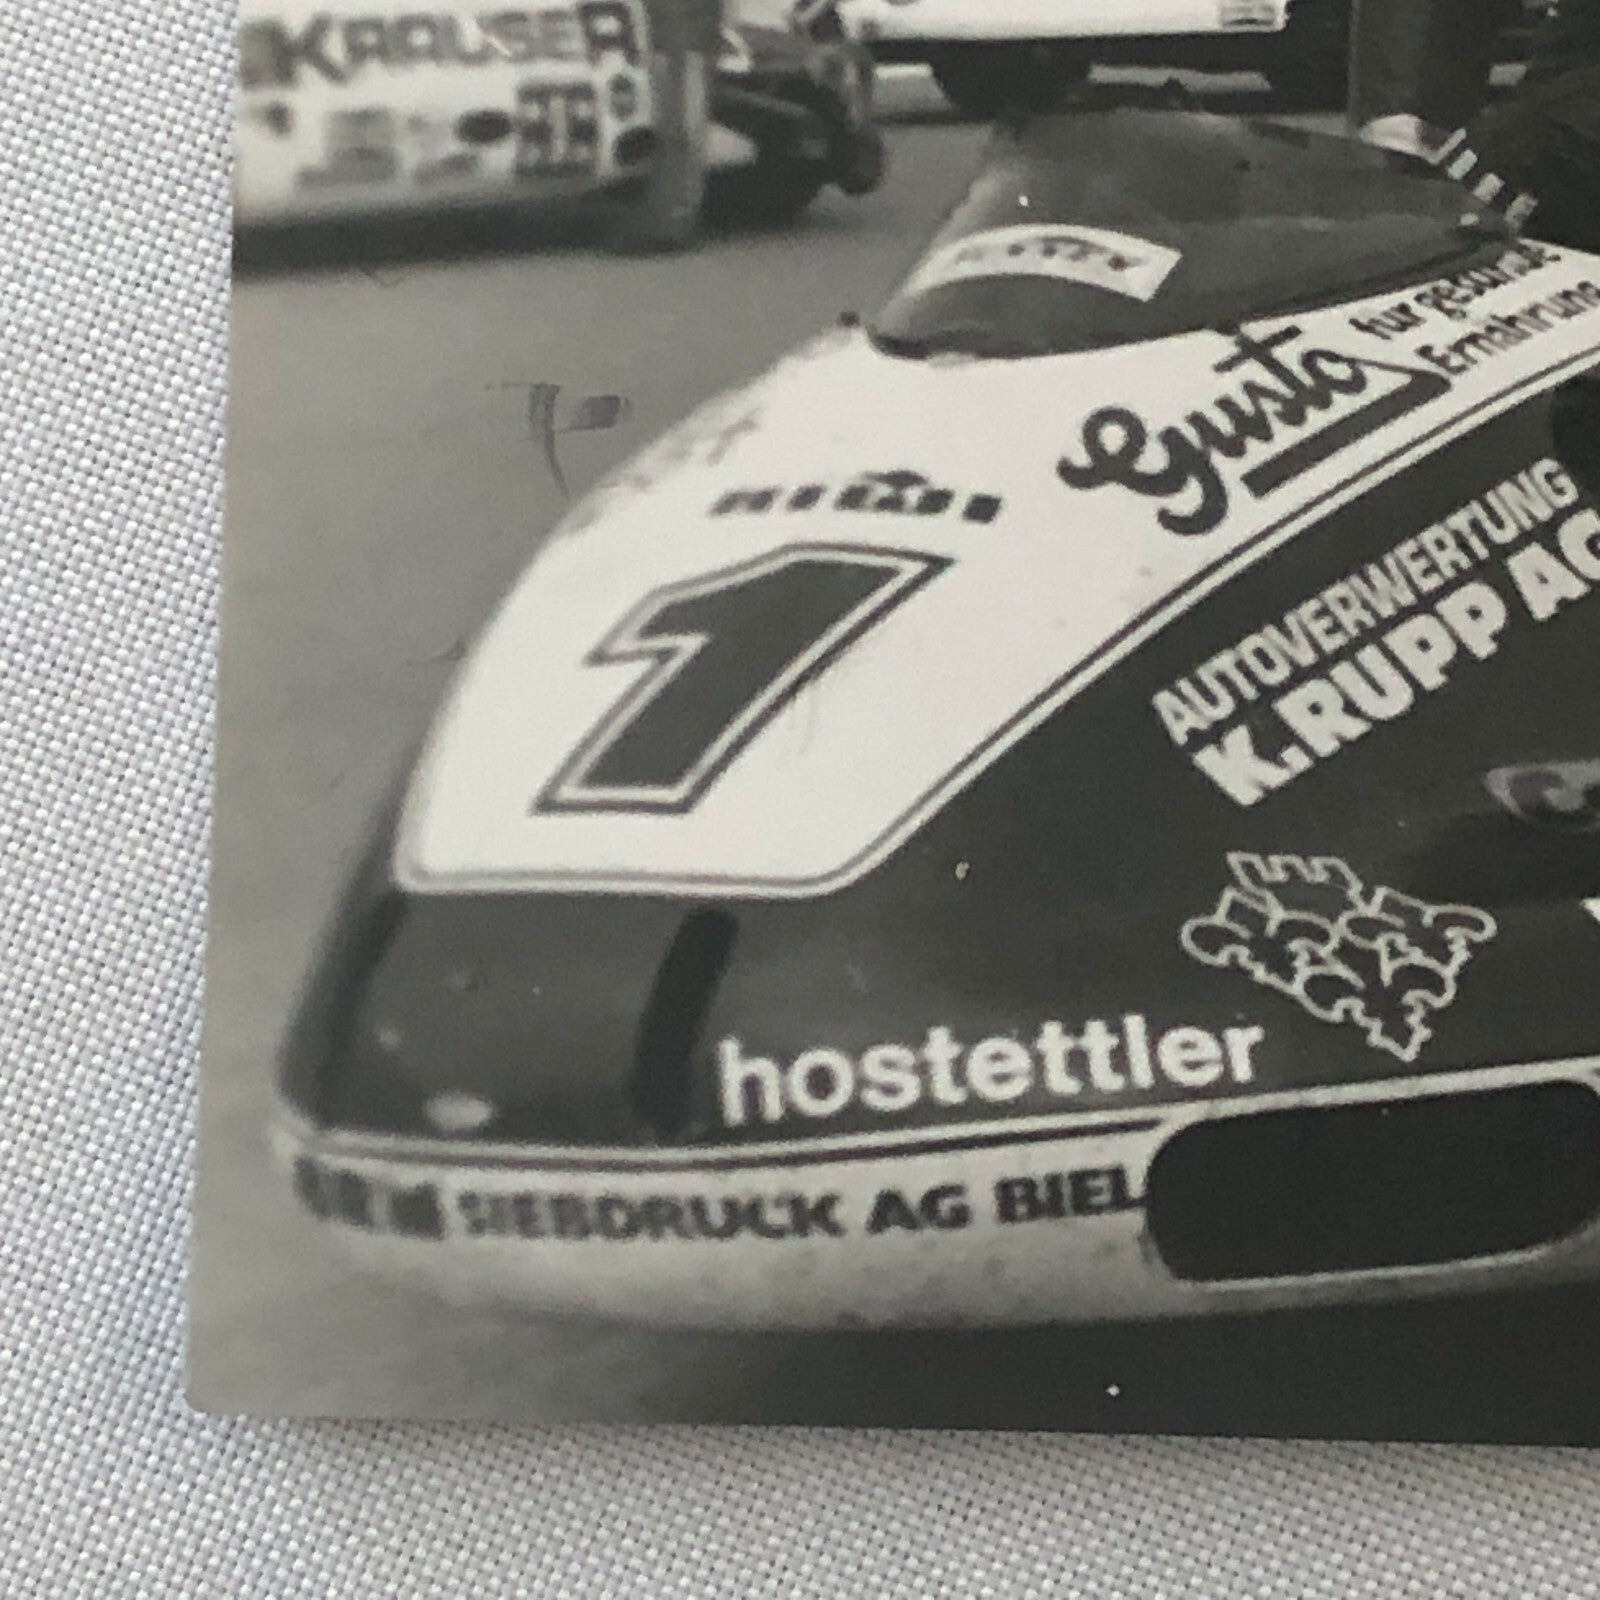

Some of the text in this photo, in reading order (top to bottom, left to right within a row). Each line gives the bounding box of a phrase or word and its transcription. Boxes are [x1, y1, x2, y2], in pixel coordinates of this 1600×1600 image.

[527, 538, 957, 815] 1
[1151, 458, 1579, 746] AUTOVERWERTUNG
[1193, 582, 1507, 806] K.RUPP
[717, 1013, 1265, 1127] hostettler
[865, 1186, 971, 1236] AG
[993, 1164, 1146, 1224] BIEL
